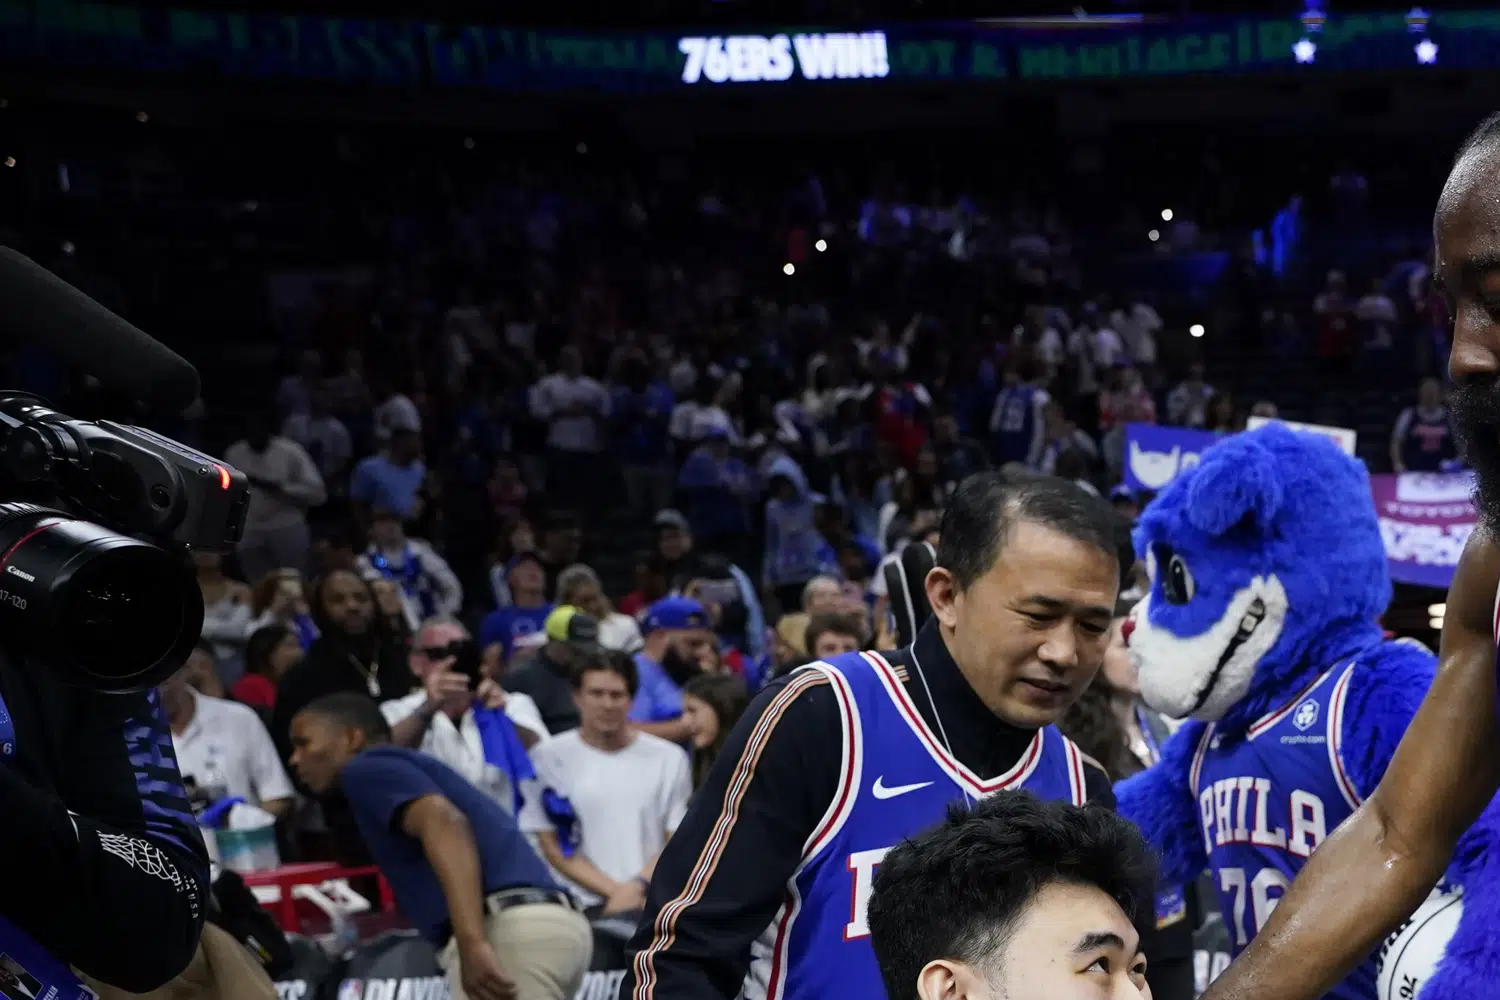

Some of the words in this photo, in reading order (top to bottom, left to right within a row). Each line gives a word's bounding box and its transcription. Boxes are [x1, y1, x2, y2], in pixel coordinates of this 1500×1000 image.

[678, 33, 795, 84] 76ERS
[793, 29, 890, 80] WIN!
[6, 565, 36, 583] Canon
[1200, 775, 1327, 860] PHILA
[1218, 866, 1288, 946] 76
